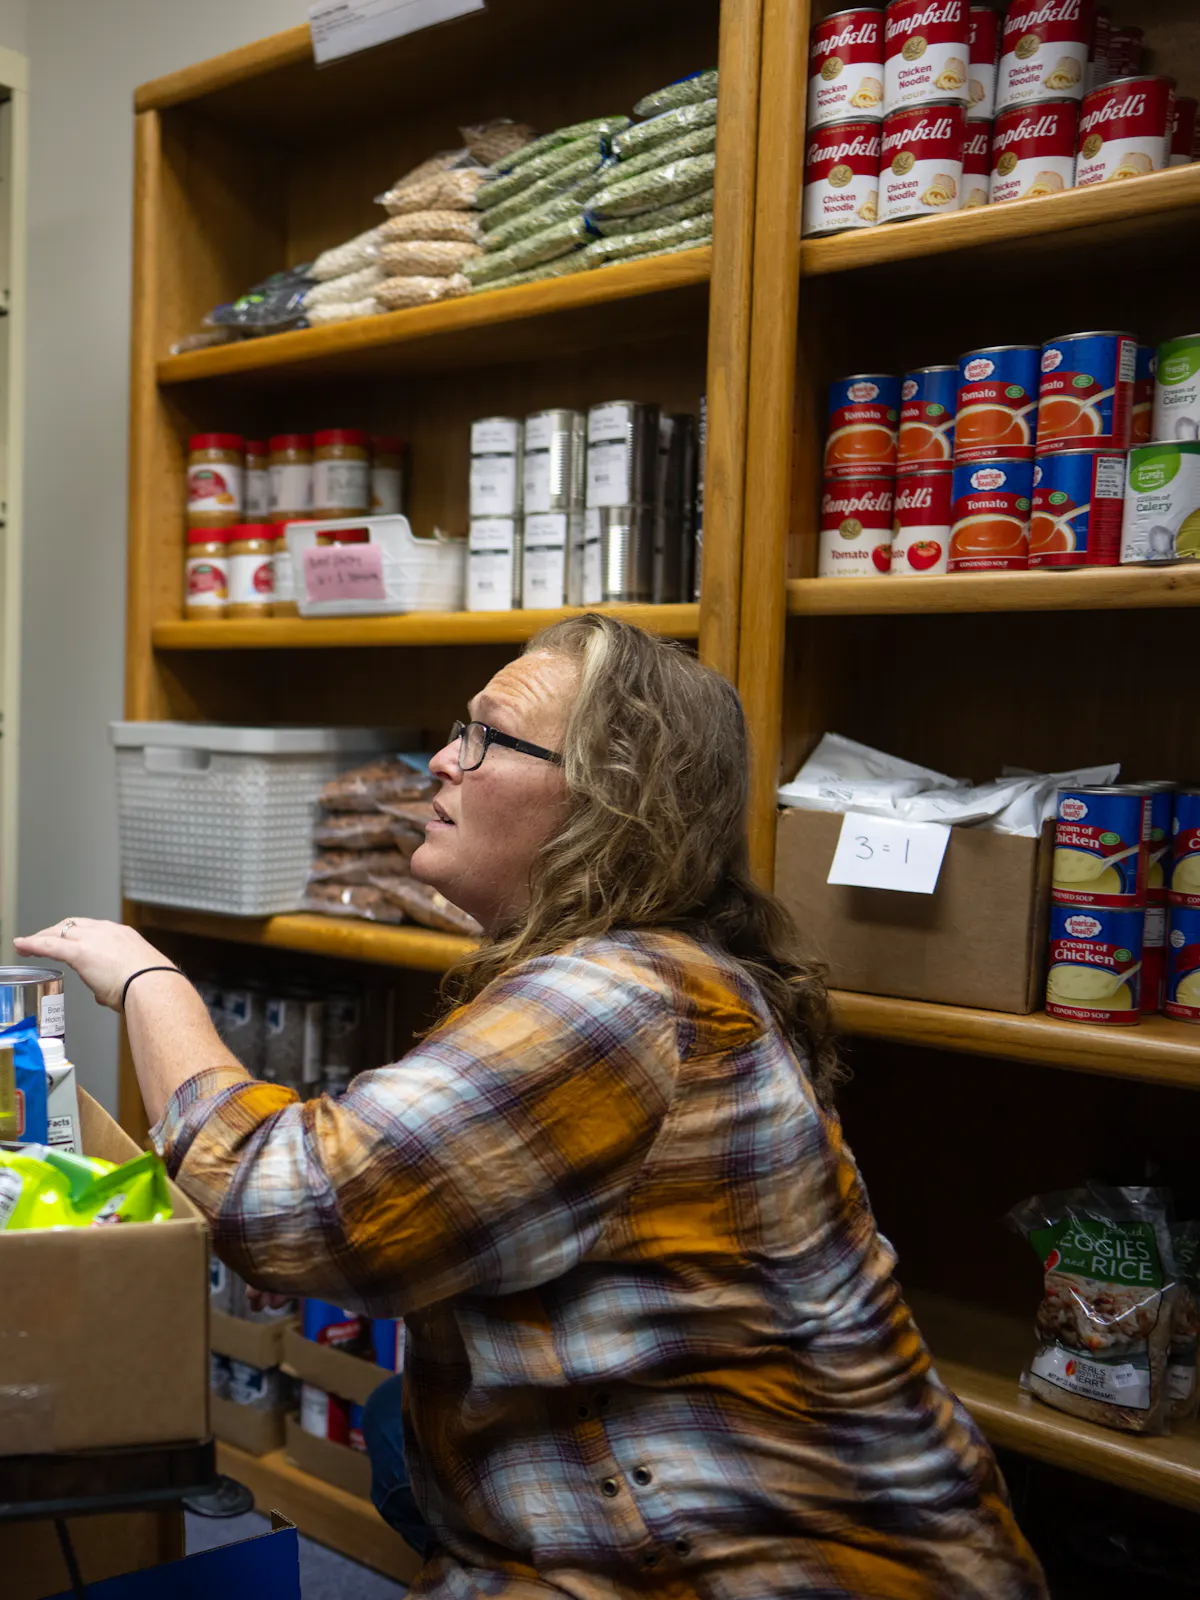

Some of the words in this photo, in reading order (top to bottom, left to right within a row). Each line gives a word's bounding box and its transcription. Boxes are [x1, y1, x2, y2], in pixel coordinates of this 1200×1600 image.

[897, 64, 932, 80] Chicken
[1008, 64, 1043, 78] Chicken
[898, 75, 931, 90] Noodle
[1008, 74, 1040, 89] Noodle
[816, 84, 848, 99] Chicken
[901, 90, 927, 102] SOUP
[817, 94, 846, 108] Noodle
[886, 179, 919, 193] Chicken
[822, 193, 857, 204] Chicken
[887, 190, 917, 203] Noodle
[823, 203, 855, 214] Noodle
[961, 389, 997, 402] Tomato
[1163, 394, 1198, 405] Celery
[844, 411, 881, 421] Tomato
[975, 472, 1002, 481] American
[977, 479, 999, 488] Beauty
[1162, 493, 1171, 501] of
[967, 499, 1008, 511] Tomato
[1136, 502, 1173, 513] Celery
[831, 550, 869, 560] Tomato
[959, 560, 992, 568] CONDENSED
[1081, 826, 1094, 836] of
[1056, 833, 1100, 849] hicken
[855, 835, 874, 860] 3
[1076, 894, 1095, 902] SOUP
[1069, 918, 1097, 928] American
[1071, 926, 1094, 936] Beauty
[1060, 940, 1094, 950] Cream
[1095, 944, 1108, 953] of
[1054, 948, 1115, 966] Chicken
[1053, 1007, 1090, 1019] CONDENSED
[1091, 1011, 1111, 1020] SOUP
[1059, 1231, 1150, 1261] EGGIES
[1063, 1258, 1087, 1269] and
[1091, 1255, 1153, 1281] RICE
